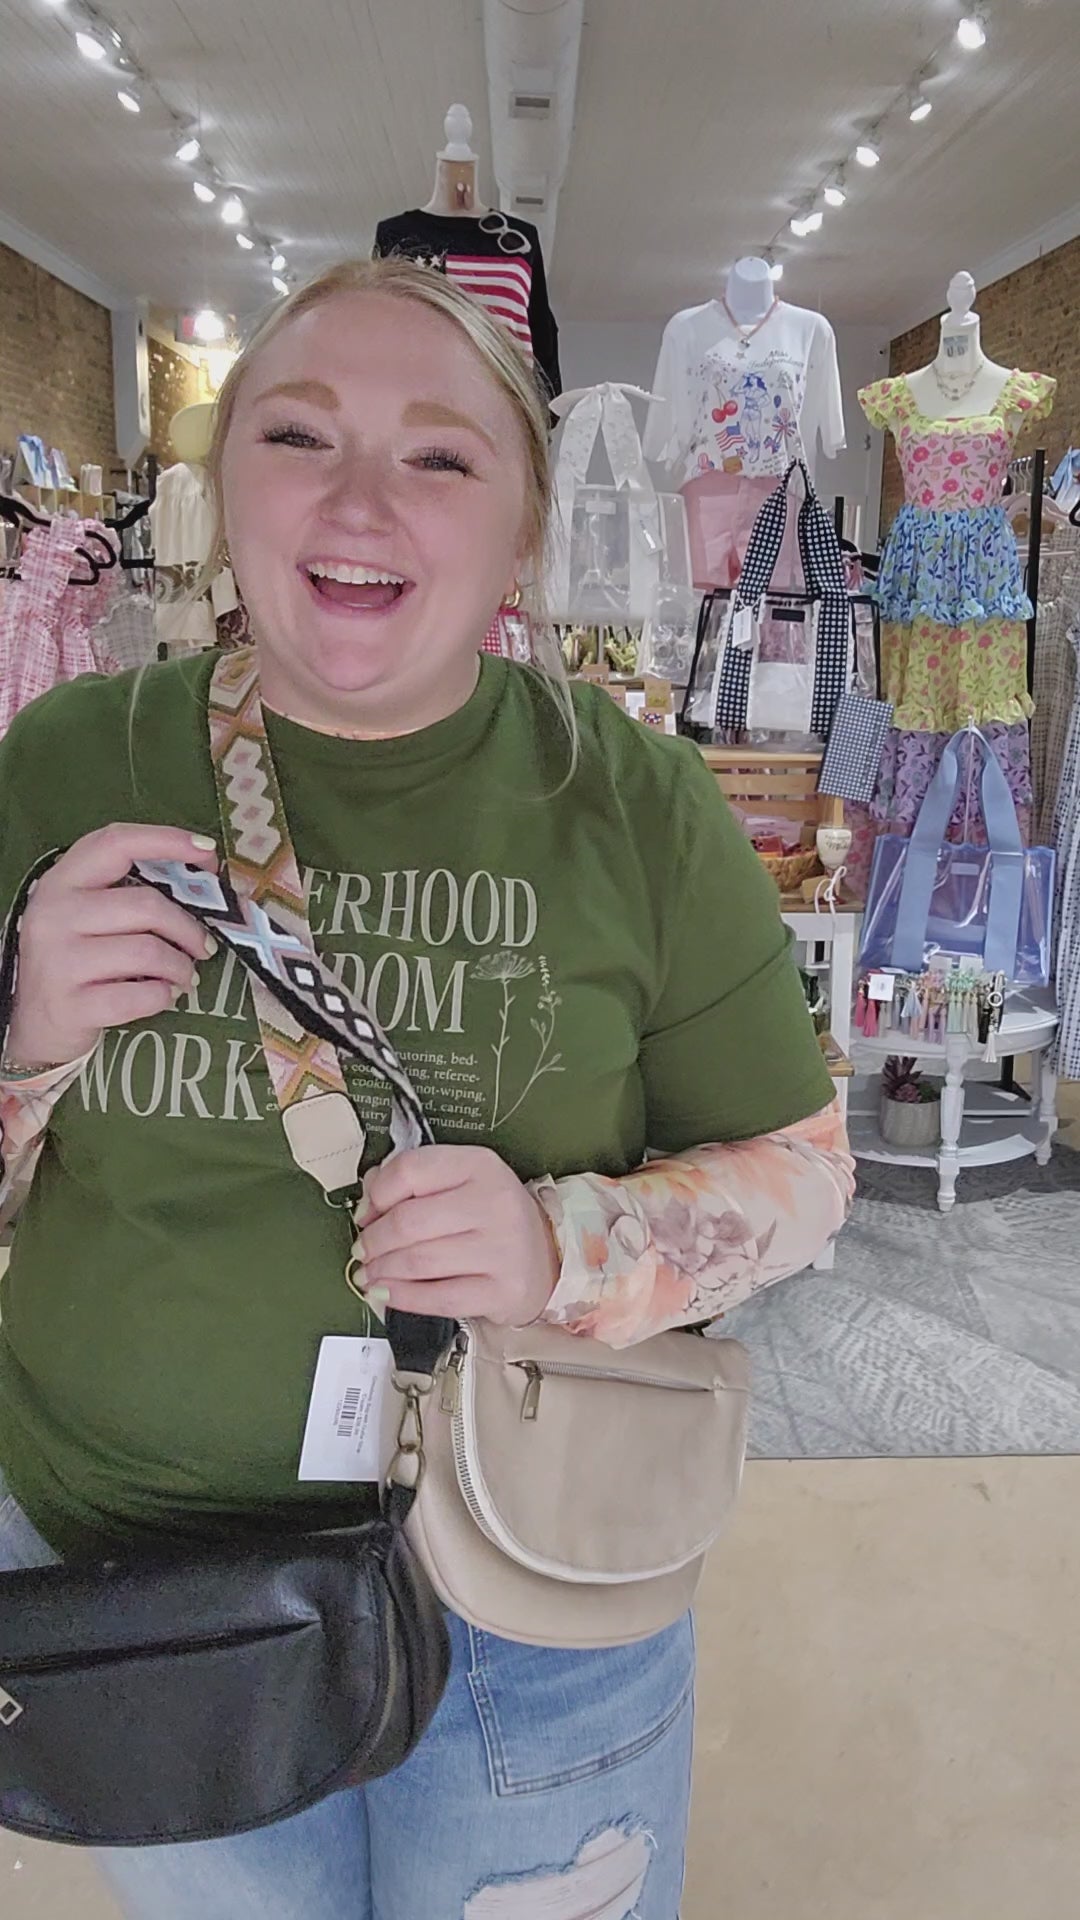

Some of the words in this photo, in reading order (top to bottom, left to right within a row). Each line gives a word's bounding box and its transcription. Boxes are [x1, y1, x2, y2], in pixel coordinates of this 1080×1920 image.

[303, 866, 538, 947] ERHOOD
[451, 1052, 479, 1065] bed-
[79, 1029, 265, 1120] WORK
[434, 1069, 481, 1083] referee-
[352, 1077, 393, 1090] cookin
[440, 1103, 482, 1118] caring,
[428, 1116, 486, 1131] mundane
